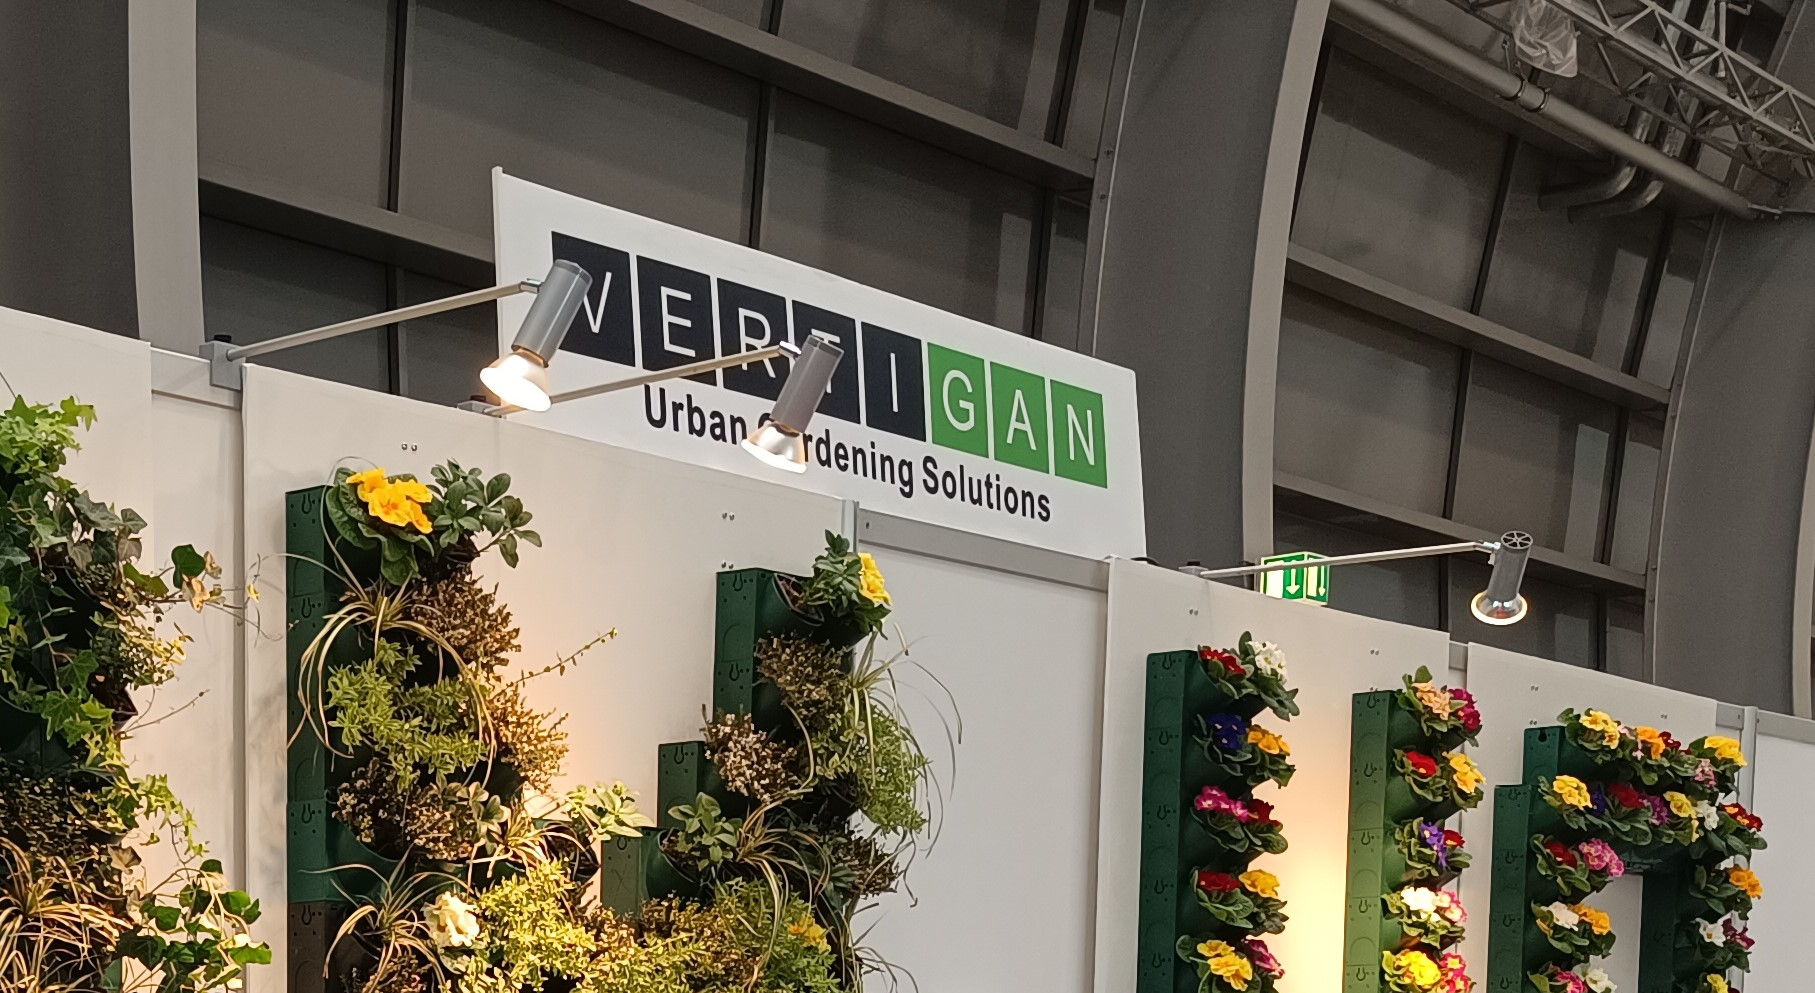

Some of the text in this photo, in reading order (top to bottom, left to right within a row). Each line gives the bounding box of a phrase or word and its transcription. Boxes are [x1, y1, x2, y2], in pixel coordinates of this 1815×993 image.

[644, 384, 1051, 522] Urban rdening Solutions
